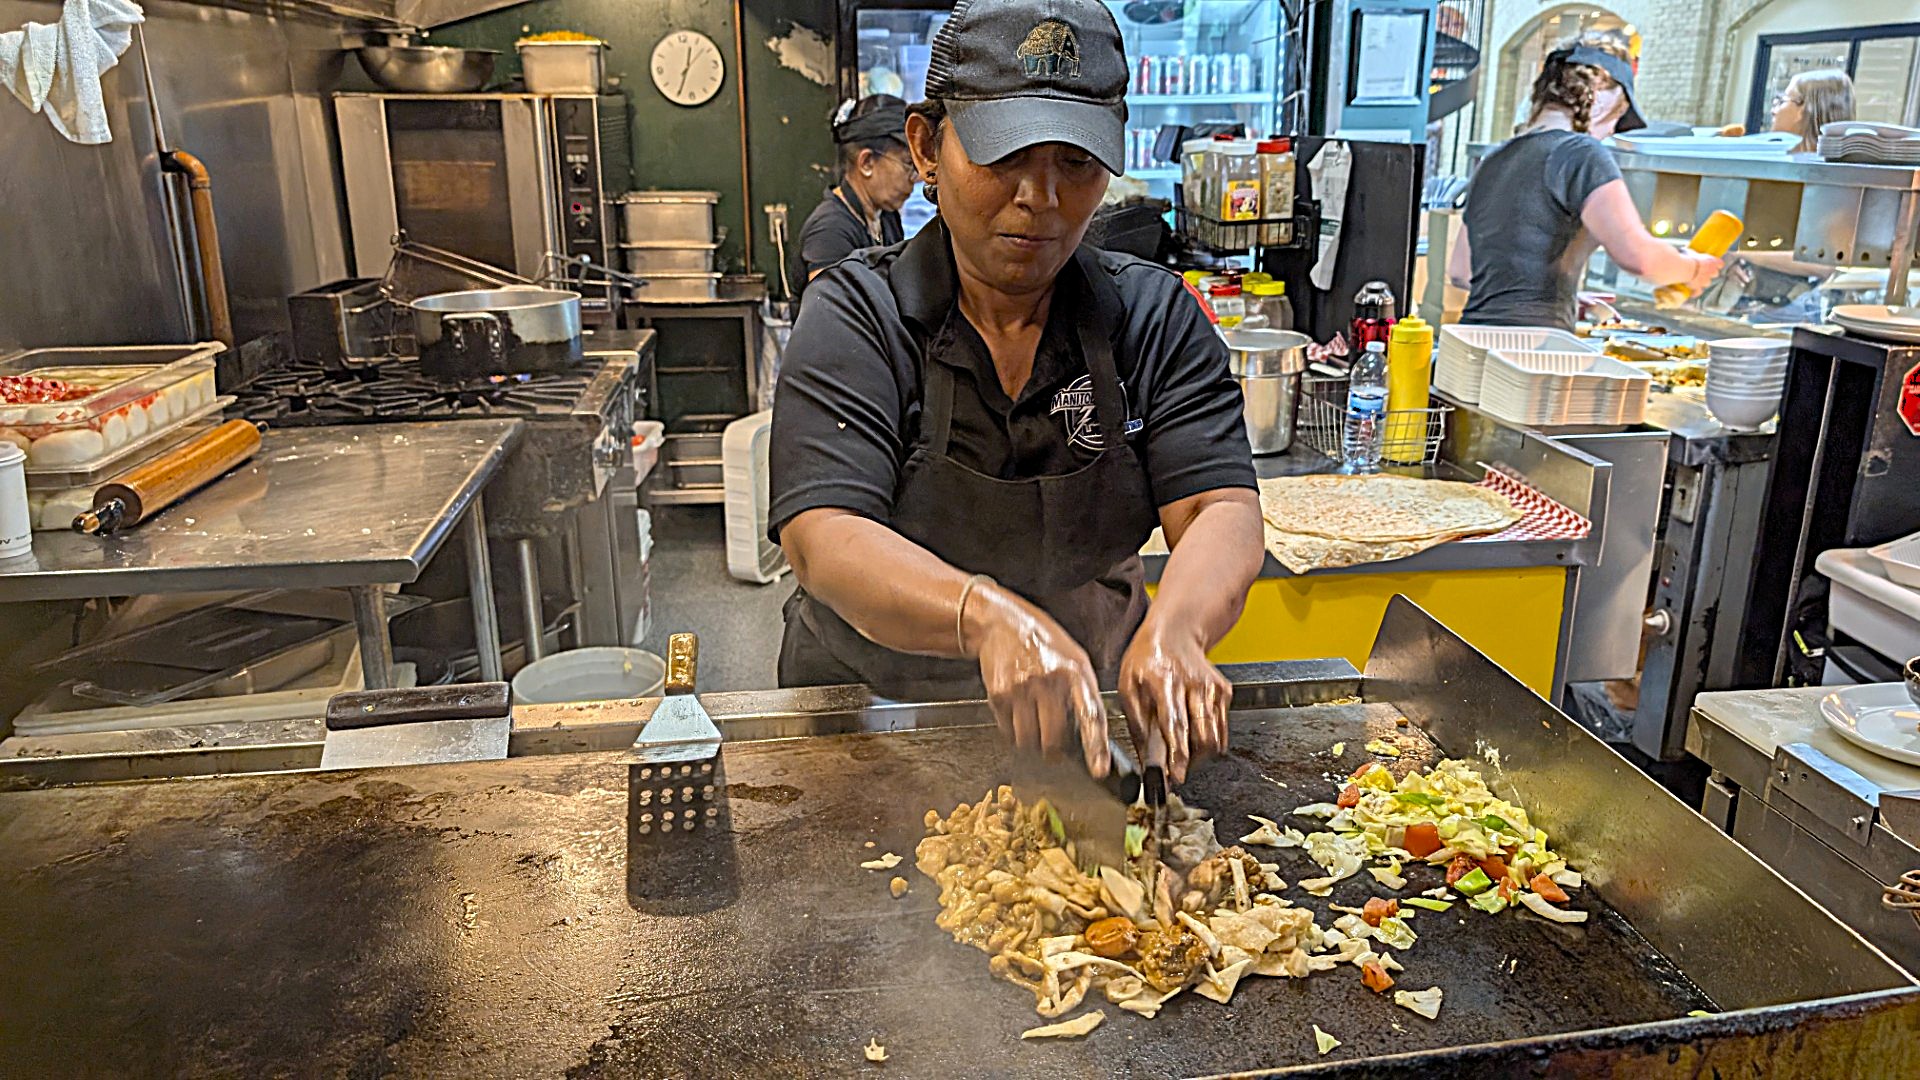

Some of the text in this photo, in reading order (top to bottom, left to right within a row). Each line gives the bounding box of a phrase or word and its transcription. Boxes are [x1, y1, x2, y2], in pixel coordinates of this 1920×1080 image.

[677, 34, 688, 44] 12
[711, 59, 719, 69] 3
[656, 66, 664, 75] 9
[688, 91, 696, 101] 6
